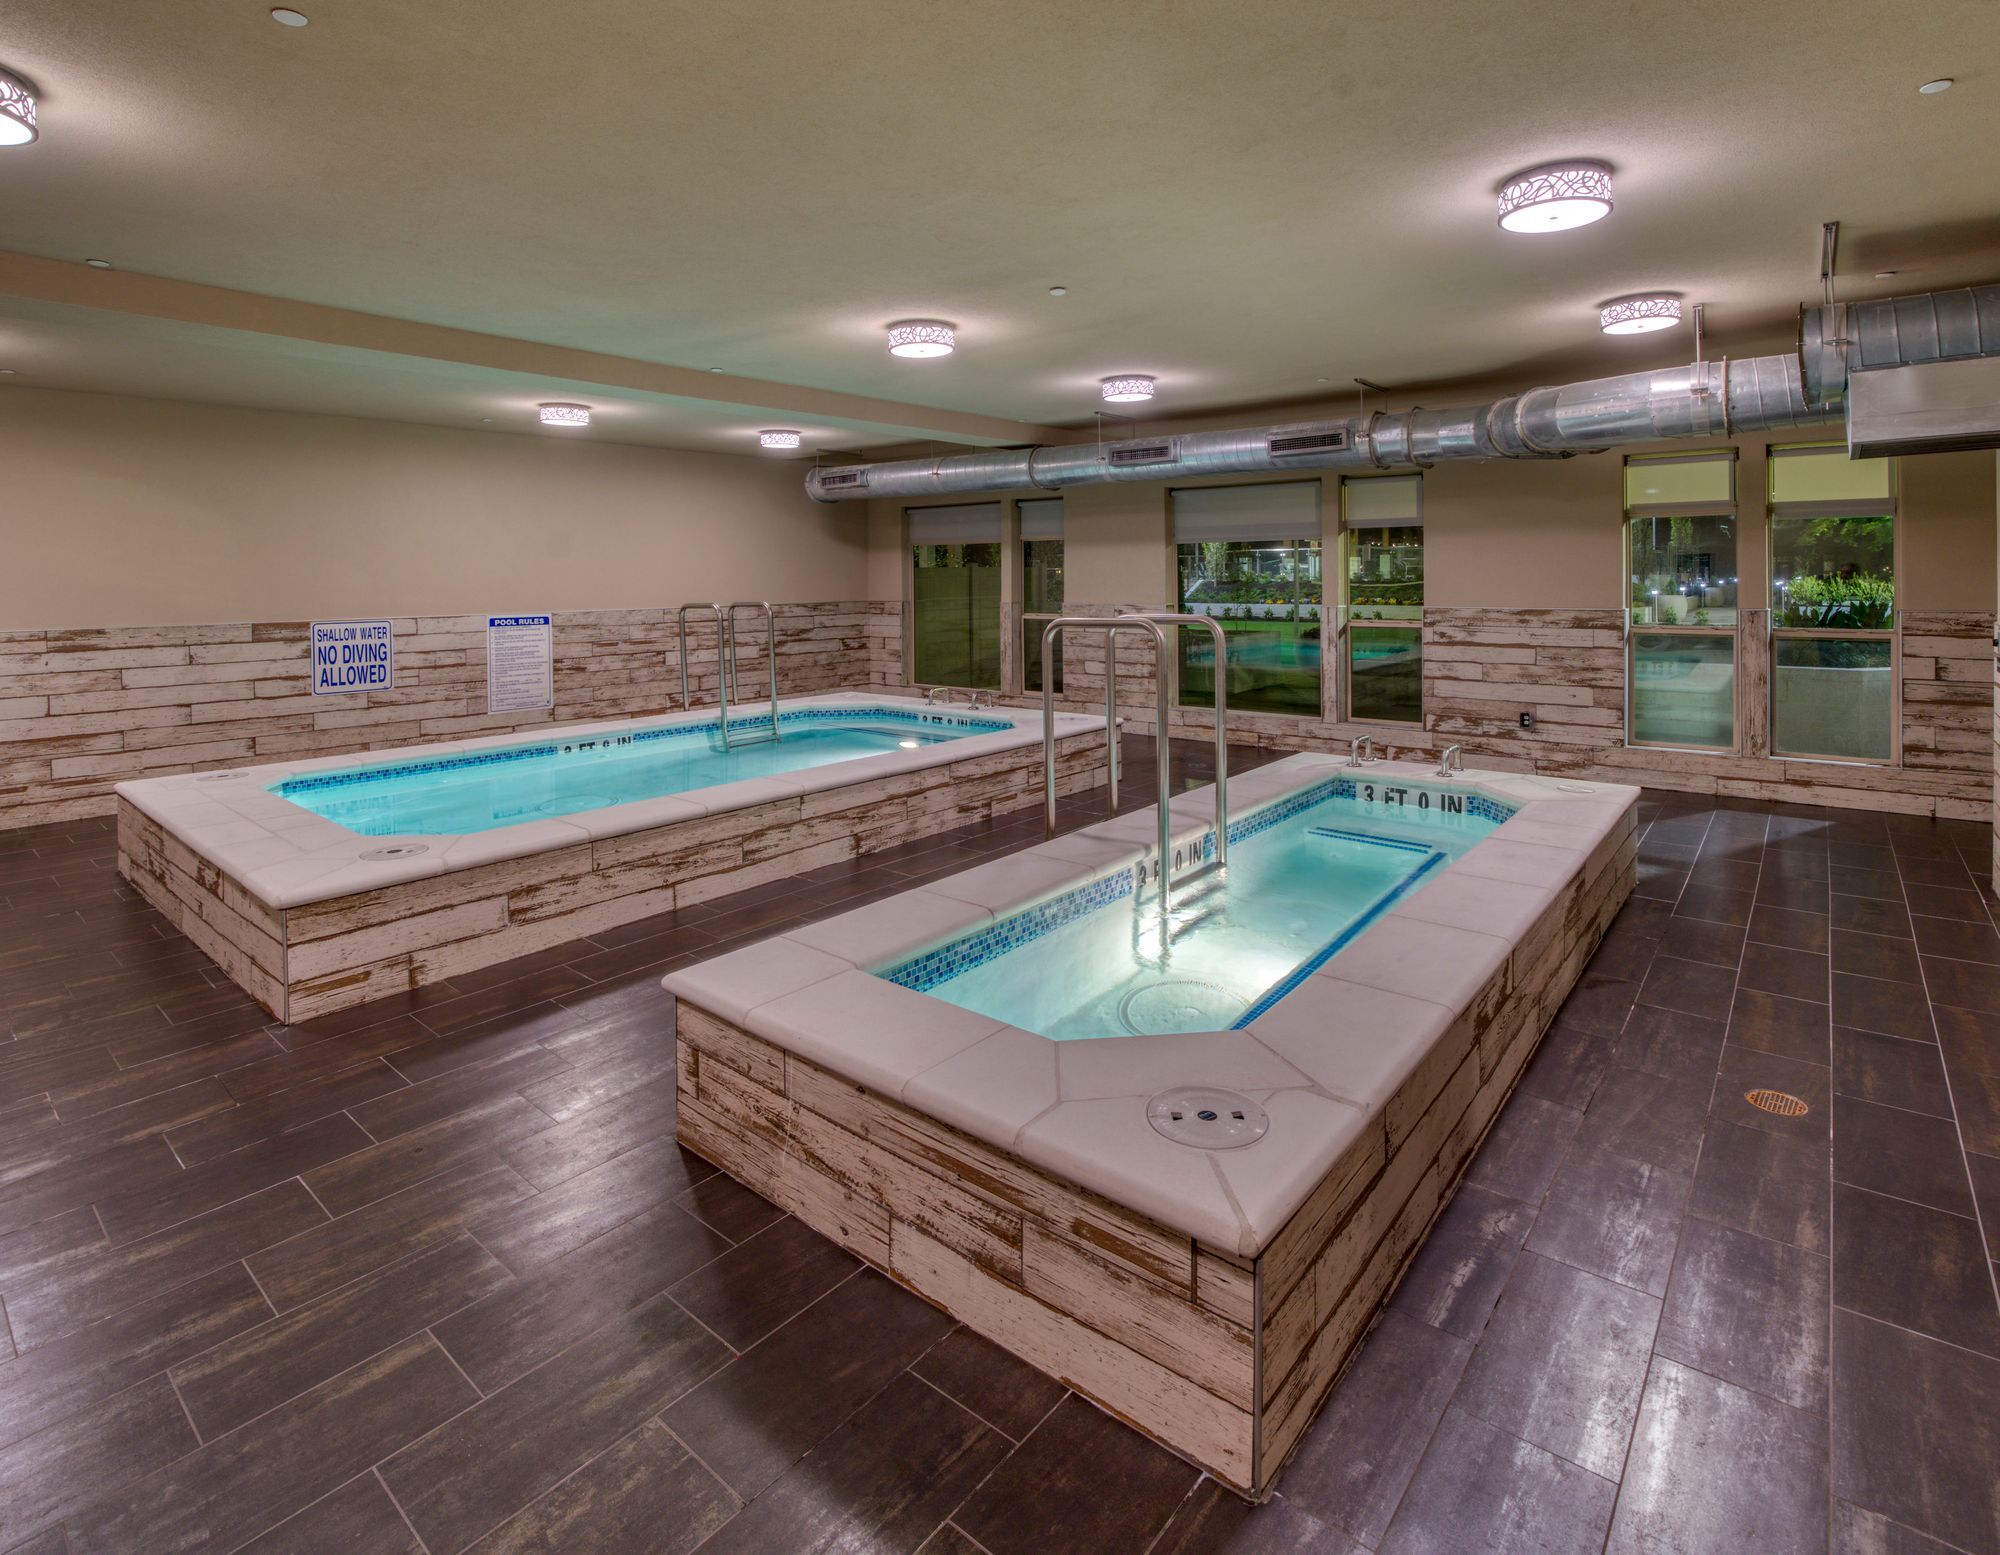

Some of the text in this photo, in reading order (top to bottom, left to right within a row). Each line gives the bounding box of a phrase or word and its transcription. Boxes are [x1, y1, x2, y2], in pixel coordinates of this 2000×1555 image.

[317, 626, 388, 642] SHALLOW WATER
[318, 643, 388, 666] NO DIVING
[320, 664, 387, 687] ALLOWED
[617, 736, 632, 746] IN
[1363, 784, 1463, 814] 3 FT 0 IN
[1175, 849, 1183, 871] 0
[1188, 839, 1202, 866] IN
